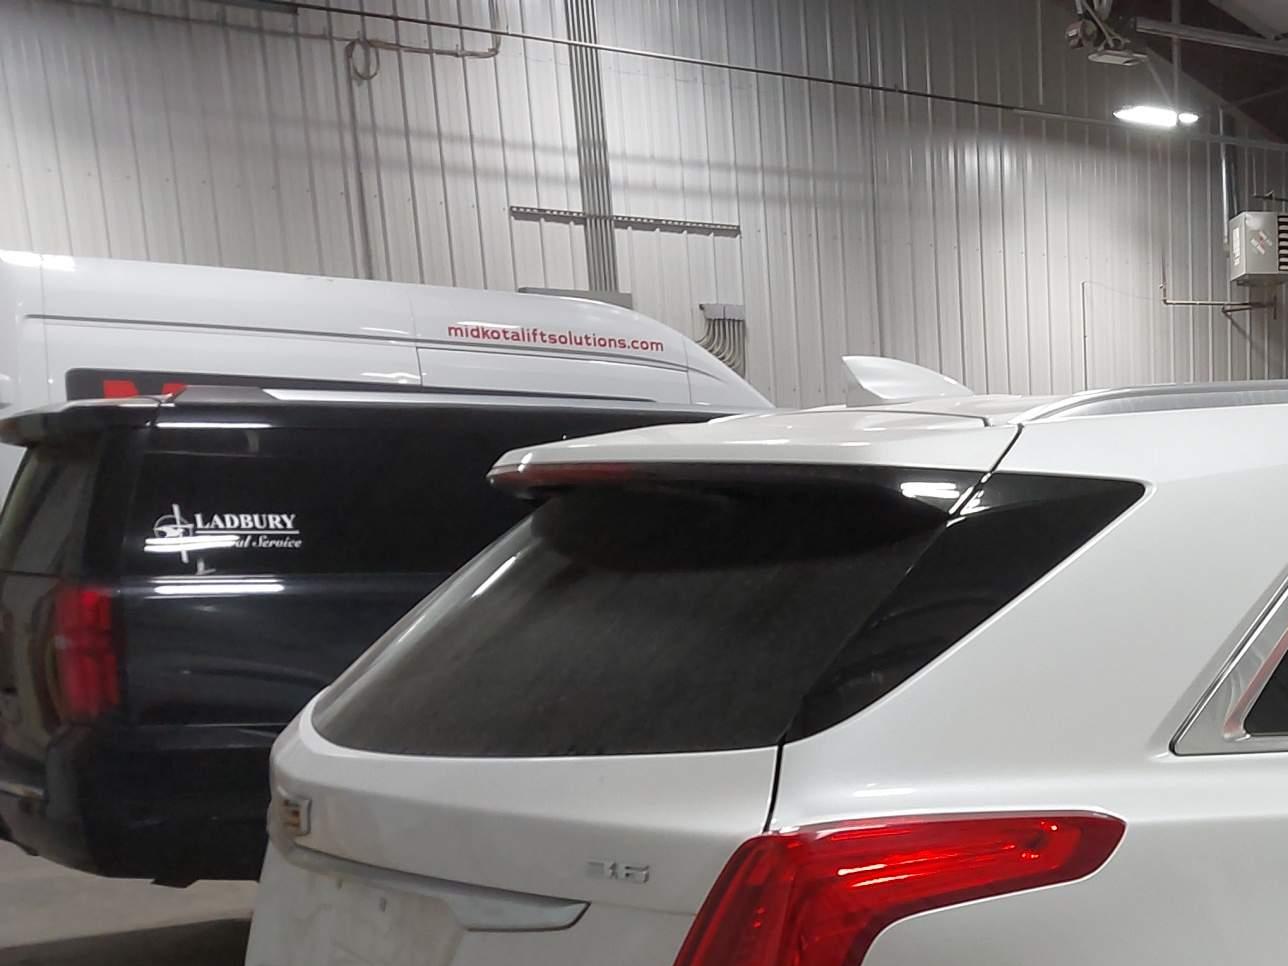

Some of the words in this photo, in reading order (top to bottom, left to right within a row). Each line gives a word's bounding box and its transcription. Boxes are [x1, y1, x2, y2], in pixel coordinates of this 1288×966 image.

[447, 325, 664, 352] midkotaliftsolutions.com
[194, 513, 297, 530] LADBURY
[252, 534, 303, 548] Service
